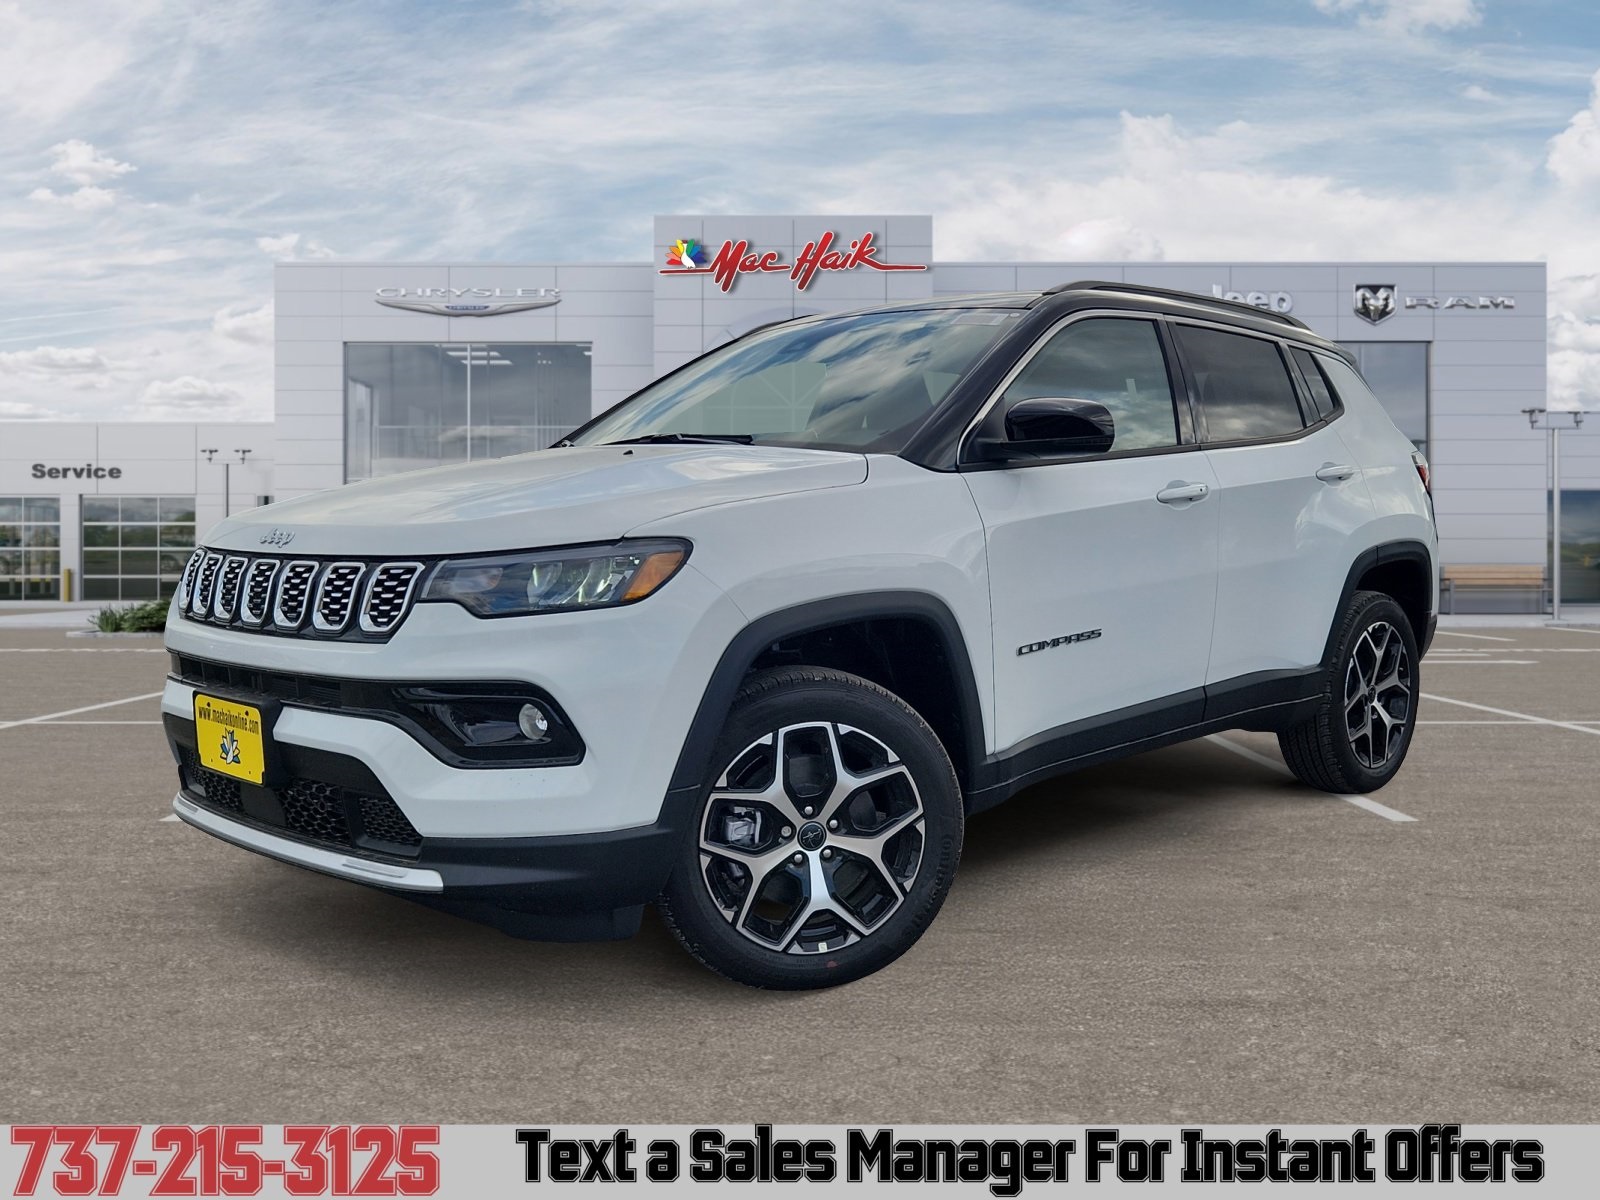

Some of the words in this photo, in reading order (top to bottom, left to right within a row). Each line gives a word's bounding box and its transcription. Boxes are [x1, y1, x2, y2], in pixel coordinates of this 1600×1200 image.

[659, 239, 791, 293] Mac
[790, 231, 928, 291] Haik
[375, 287, 561, 298] CHRYSLER
[1404, 296, 1515, 309] RAM
[31, 463, 122, 479] Service
[259, 527, 296, 548] Jeep
[1016, 628, 1102, 656] COMPASS
